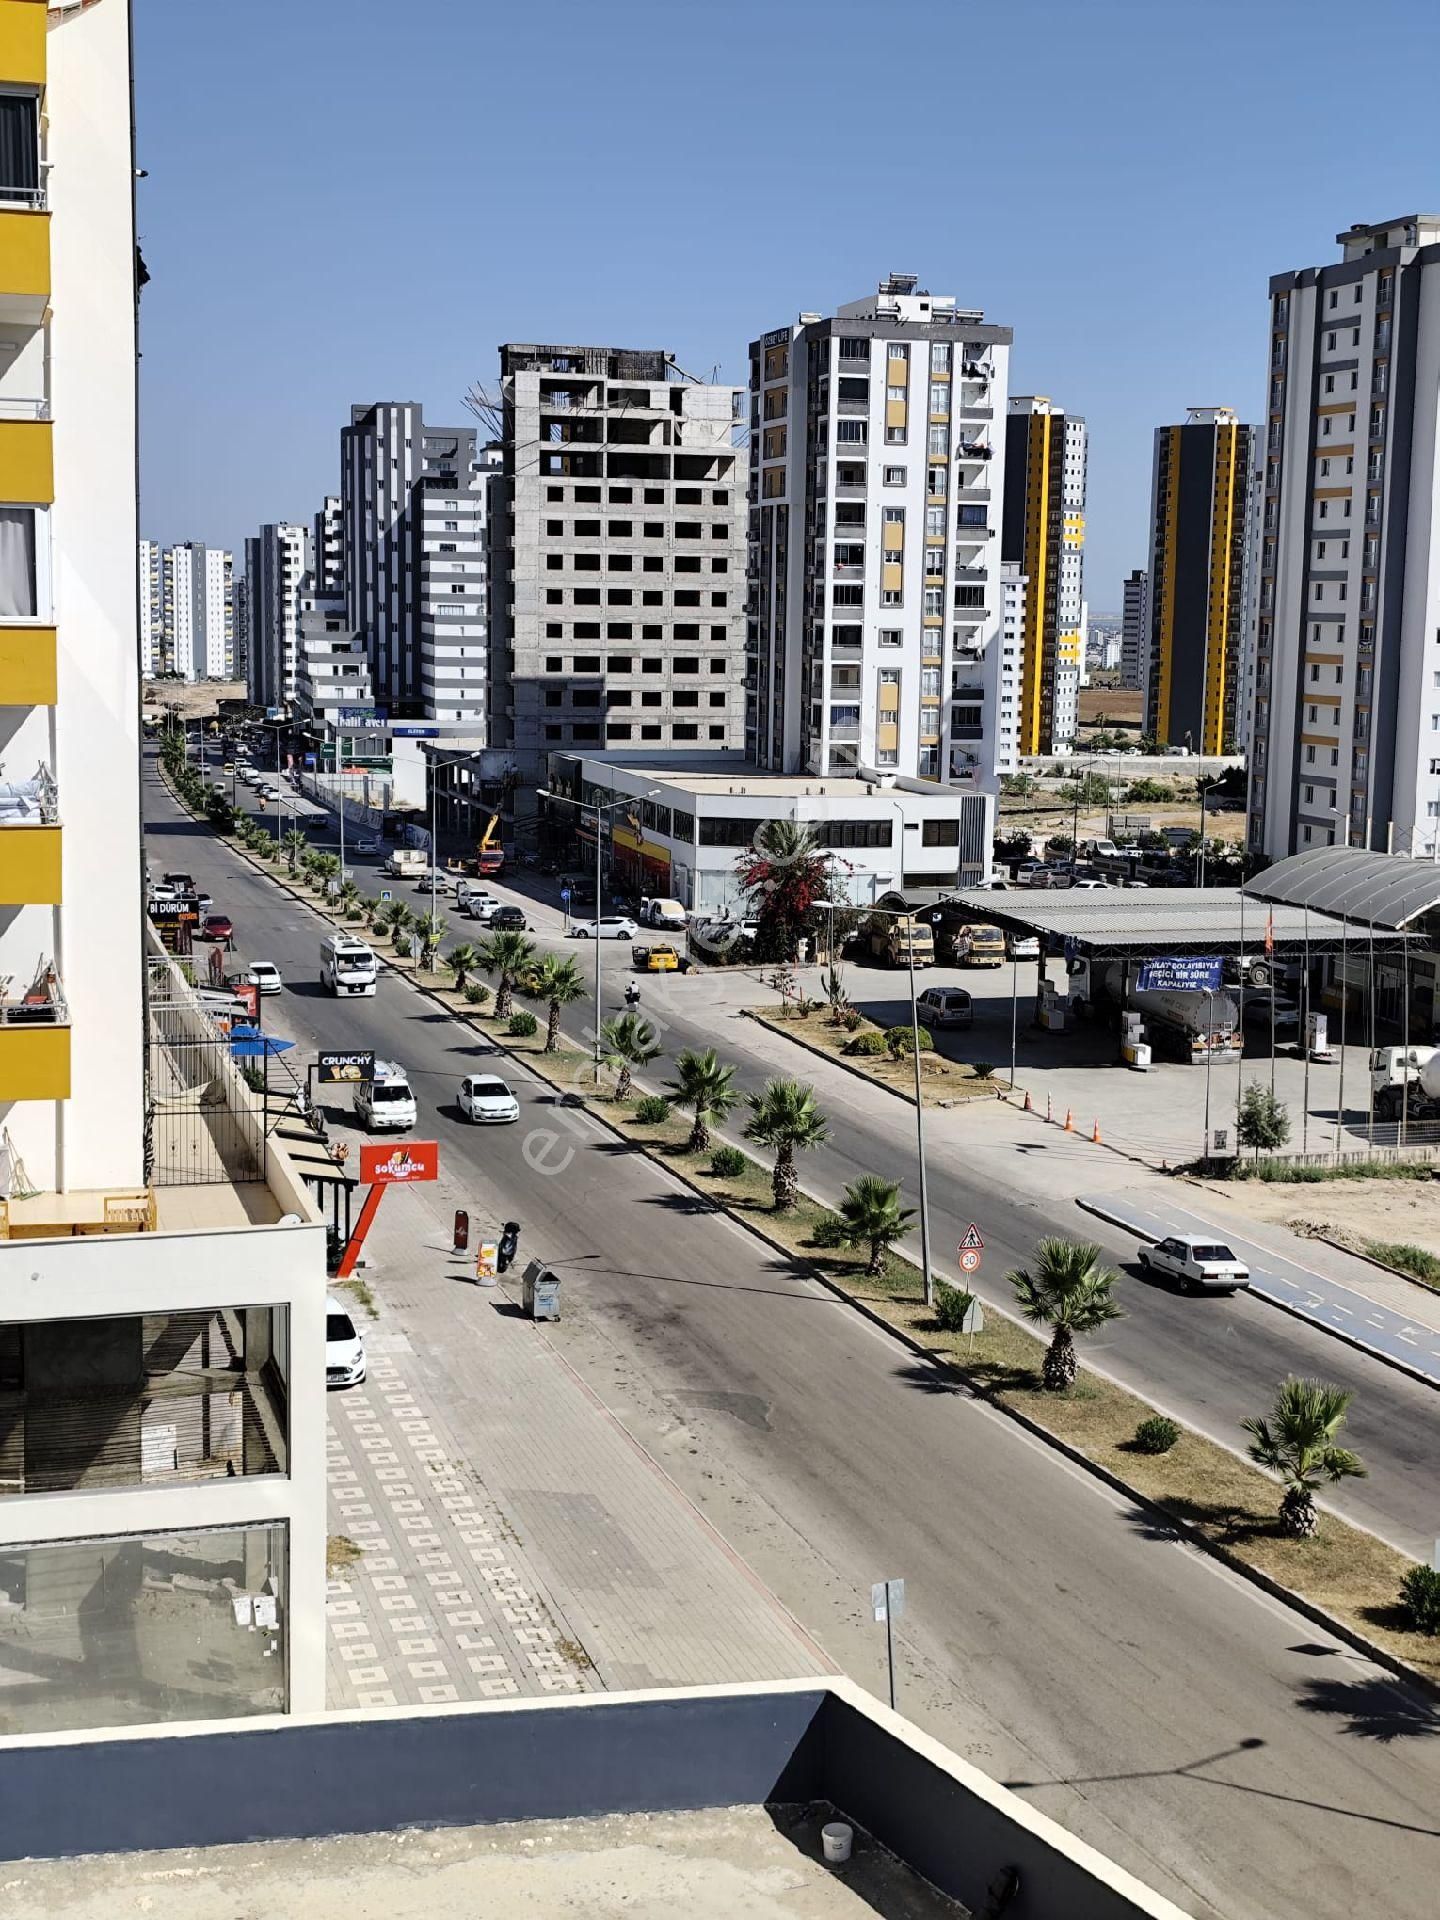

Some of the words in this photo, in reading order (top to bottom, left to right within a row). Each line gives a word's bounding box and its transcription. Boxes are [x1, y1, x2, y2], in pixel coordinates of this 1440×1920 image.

[160, 902, 189, 913] DÜRÜM
[322, 1056, 372, 1065] CRUNCHY
[964, 1255, 976, 1265] 30
